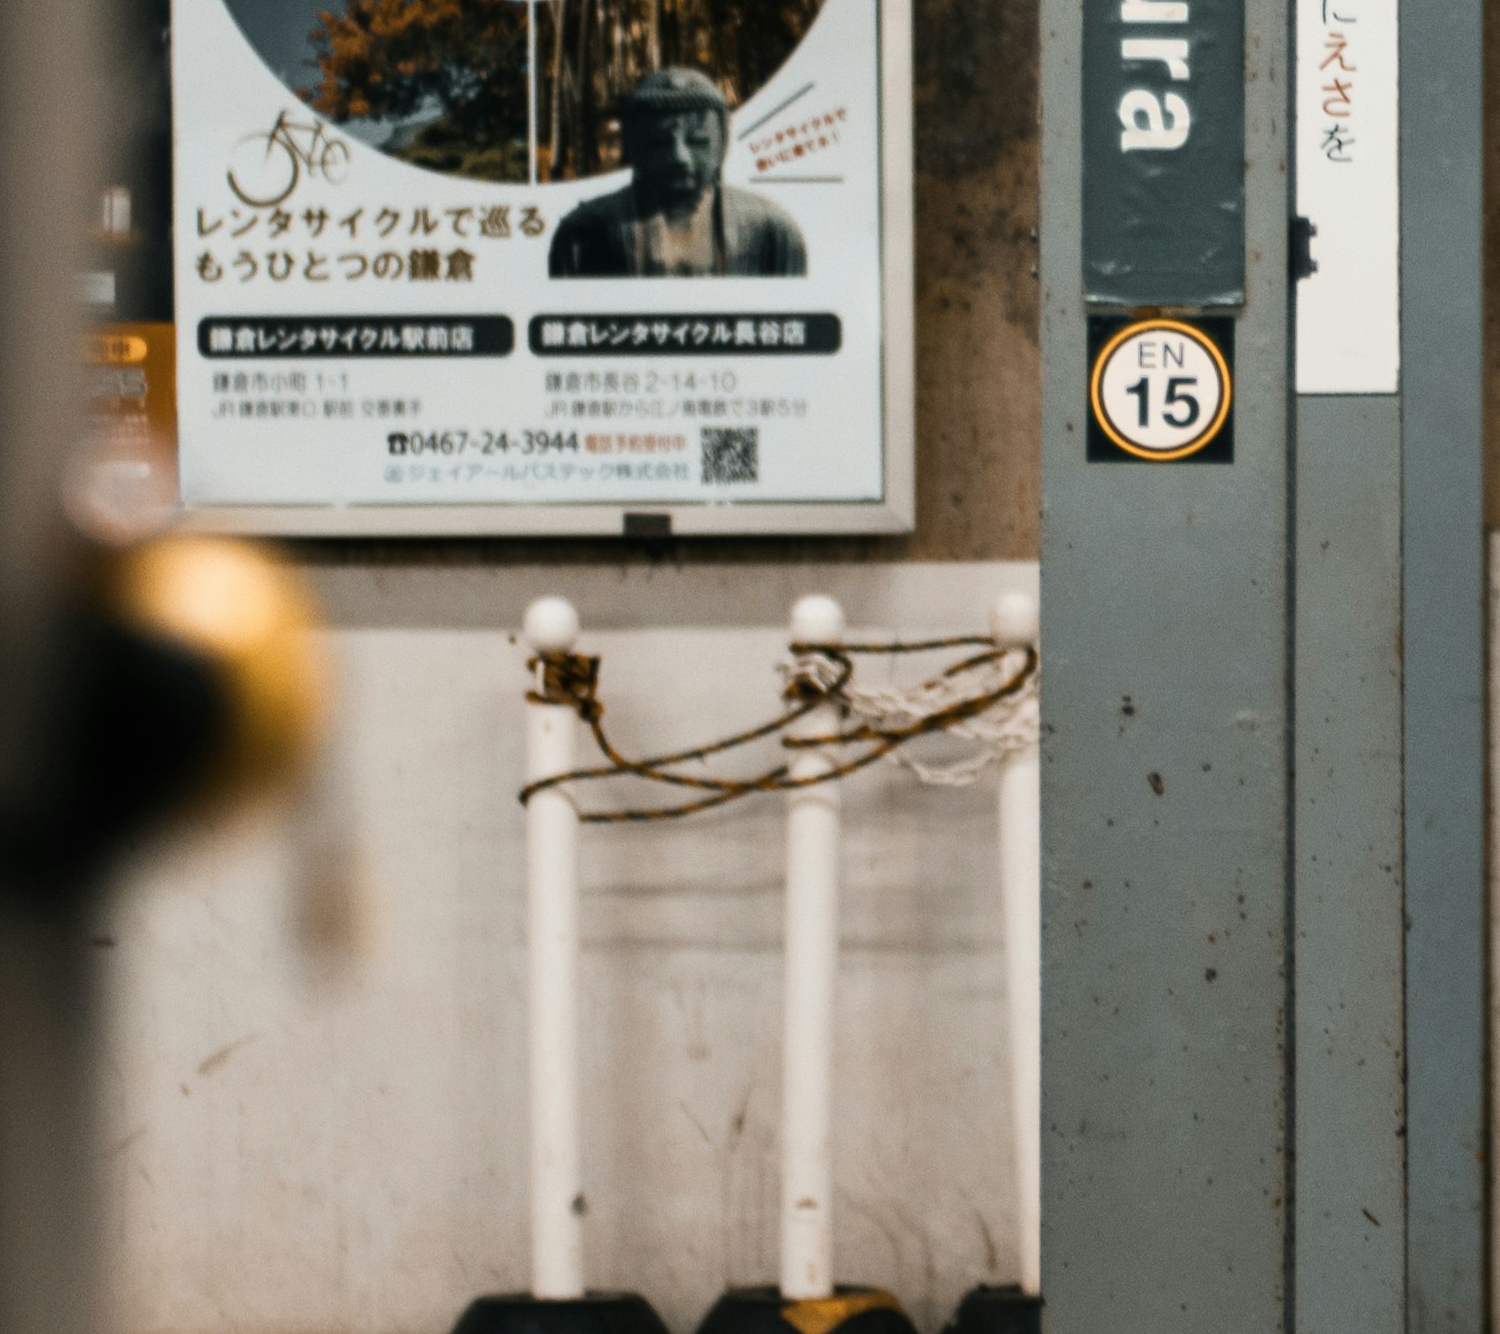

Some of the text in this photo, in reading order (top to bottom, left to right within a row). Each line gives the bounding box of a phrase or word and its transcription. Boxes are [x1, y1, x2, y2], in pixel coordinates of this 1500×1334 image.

[197, 205, 546, 239] レンタサイクルで巡る
[196, 247, 477, 283] もうひとつの鎌倉
[1138, 341, 1185, 368] EN
[1125, 375, 1201, 429] 15
[409, 431, 579, 455] 0467-24-3944
